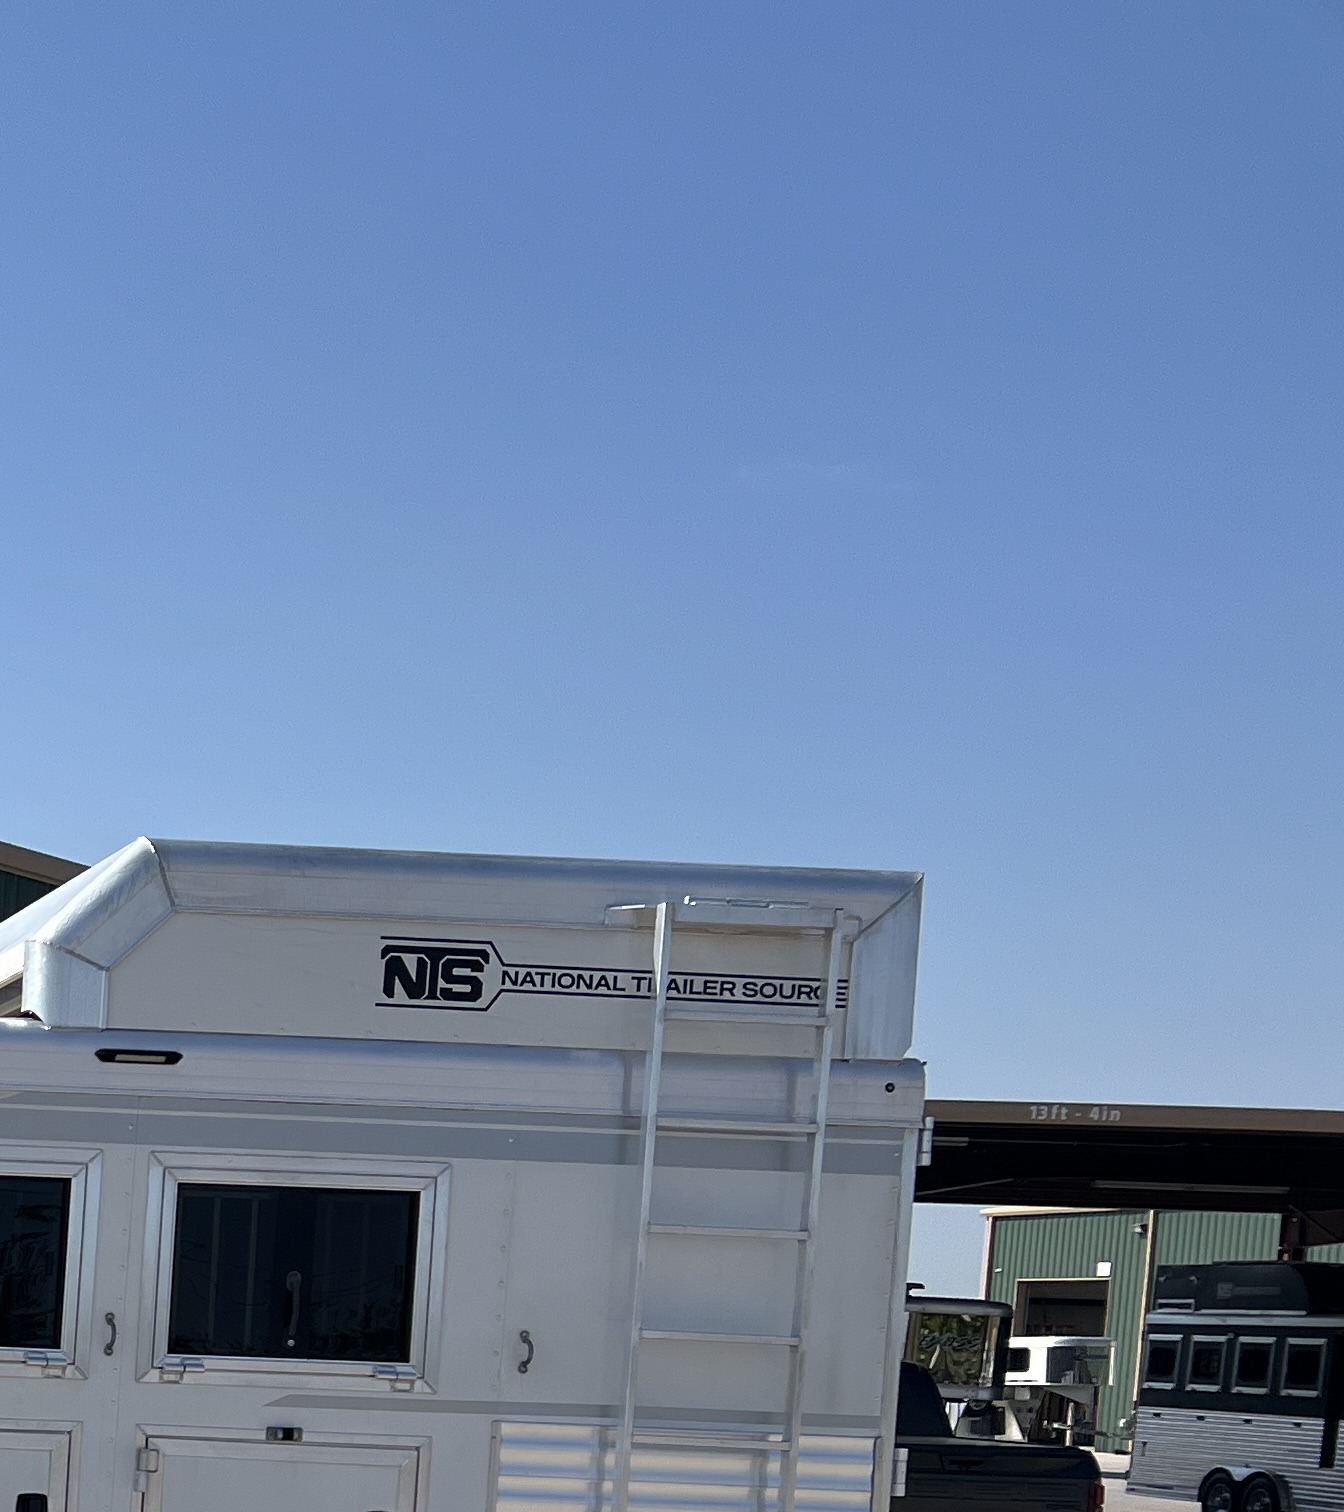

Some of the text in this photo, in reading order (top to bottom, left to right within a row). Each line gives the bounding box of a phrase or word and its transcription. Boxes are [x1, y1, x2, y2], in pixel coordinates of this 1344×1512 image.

[379, 943, 491, 1003] NTS
[501, 969, 626, 993] NATIONAL
[742, 980, 821, 1001] SOUR
[1030, 1104, 1068, 1121] 13ft
[1089, 1107, 1122, 1122] 4in
